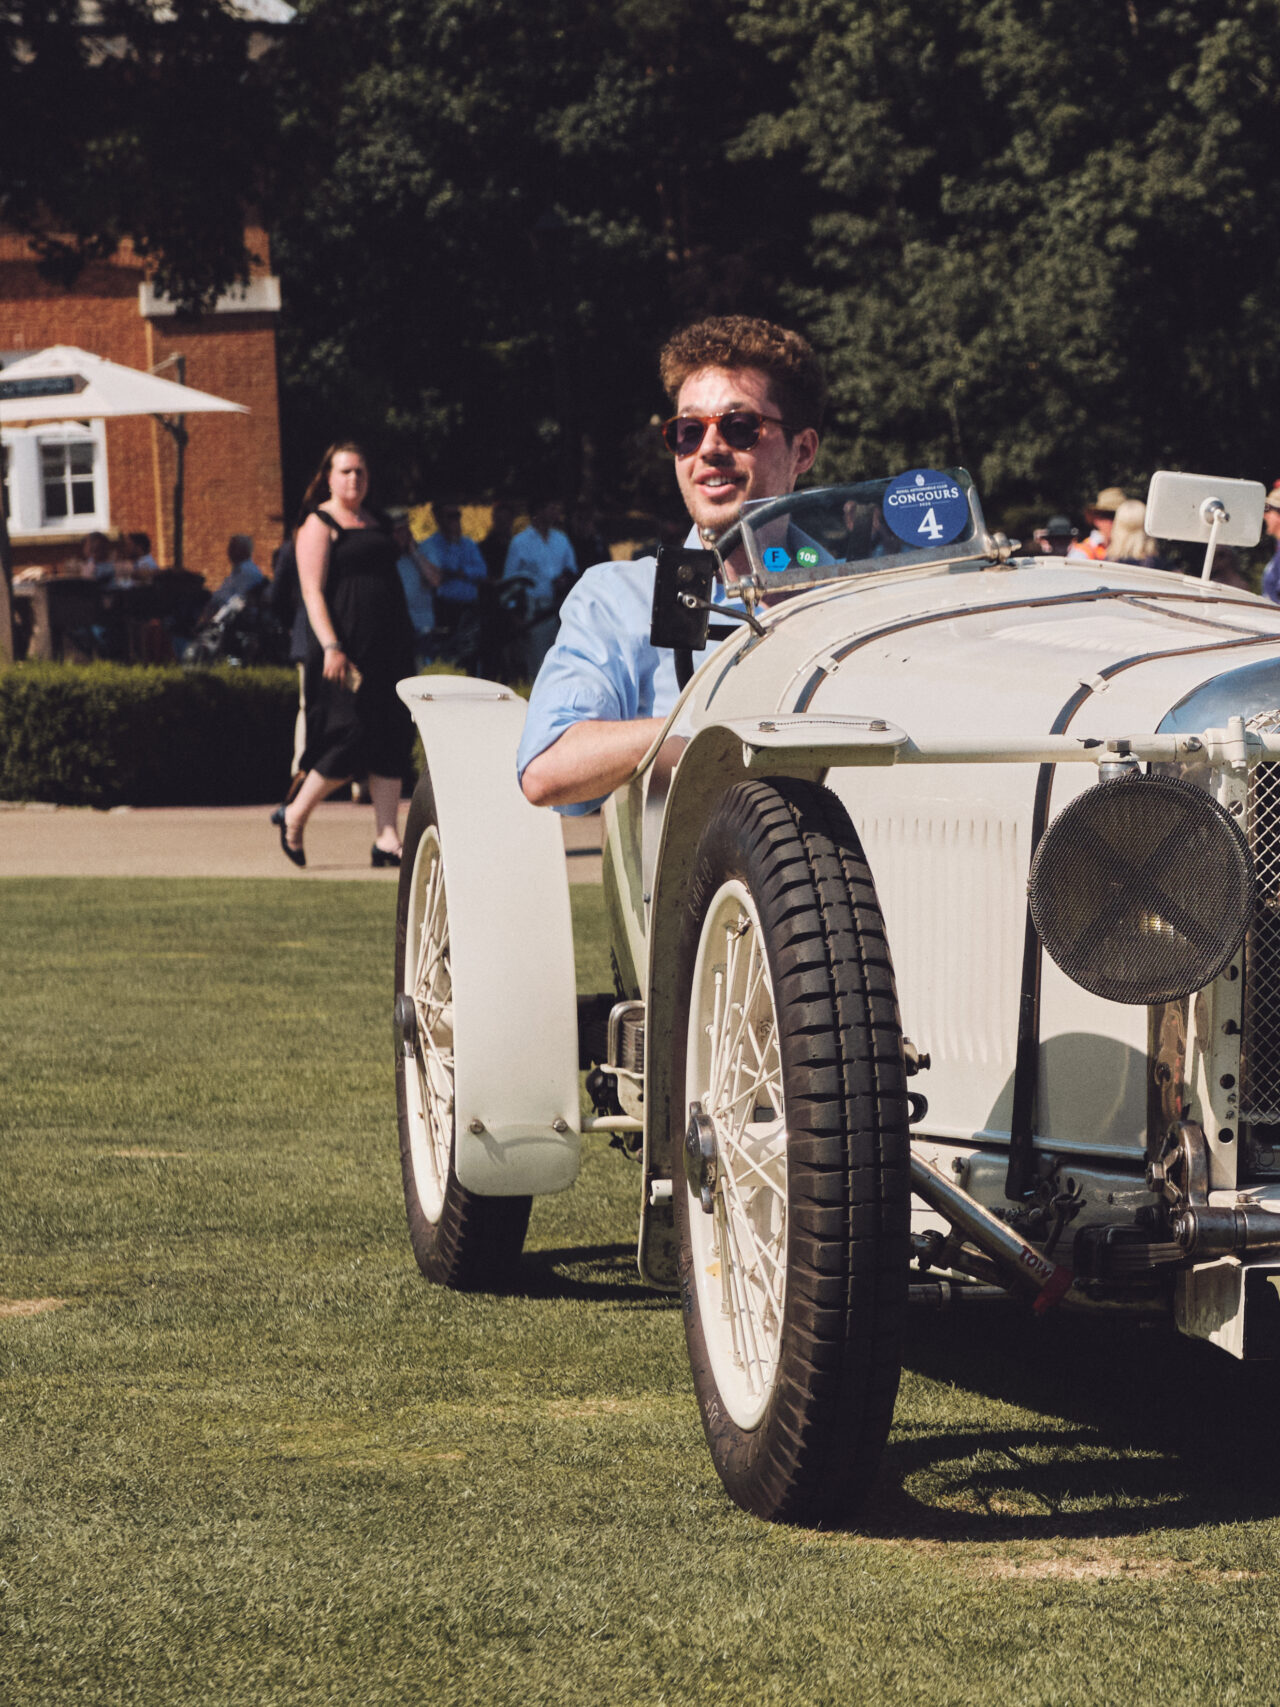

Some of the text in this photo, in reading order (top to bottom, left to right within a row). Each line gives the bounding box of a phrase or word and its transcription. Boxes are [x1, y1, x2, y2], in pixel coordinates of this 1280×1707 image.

[888, 487, 959, 506] CONCOURS
[917, 507, 944, 540] 4
[772, 551, 780, 563] F
